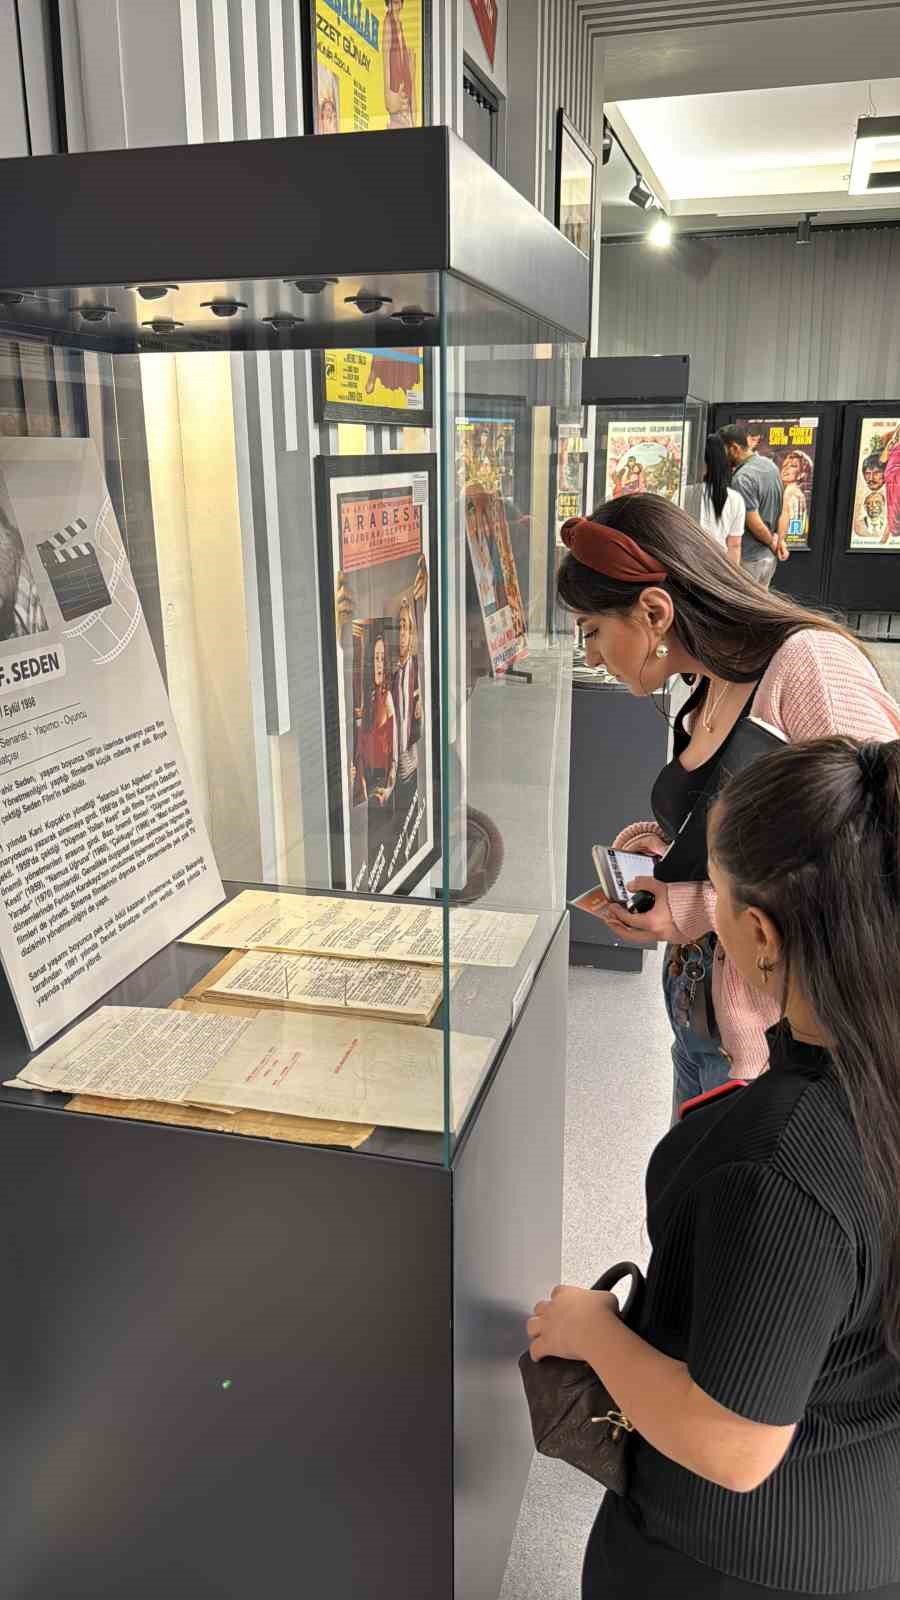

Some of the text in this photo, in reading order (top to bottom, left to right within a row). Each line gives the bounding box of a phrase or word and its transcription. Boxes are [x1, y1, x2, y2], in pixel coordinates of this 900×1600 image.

[343, 506, 419, 533] ARABESK
[11, 652, 59, 682] SEDEN
[3, 700, 20, 718] Eylül
[33, 720, 59, 736] Yapımcı
